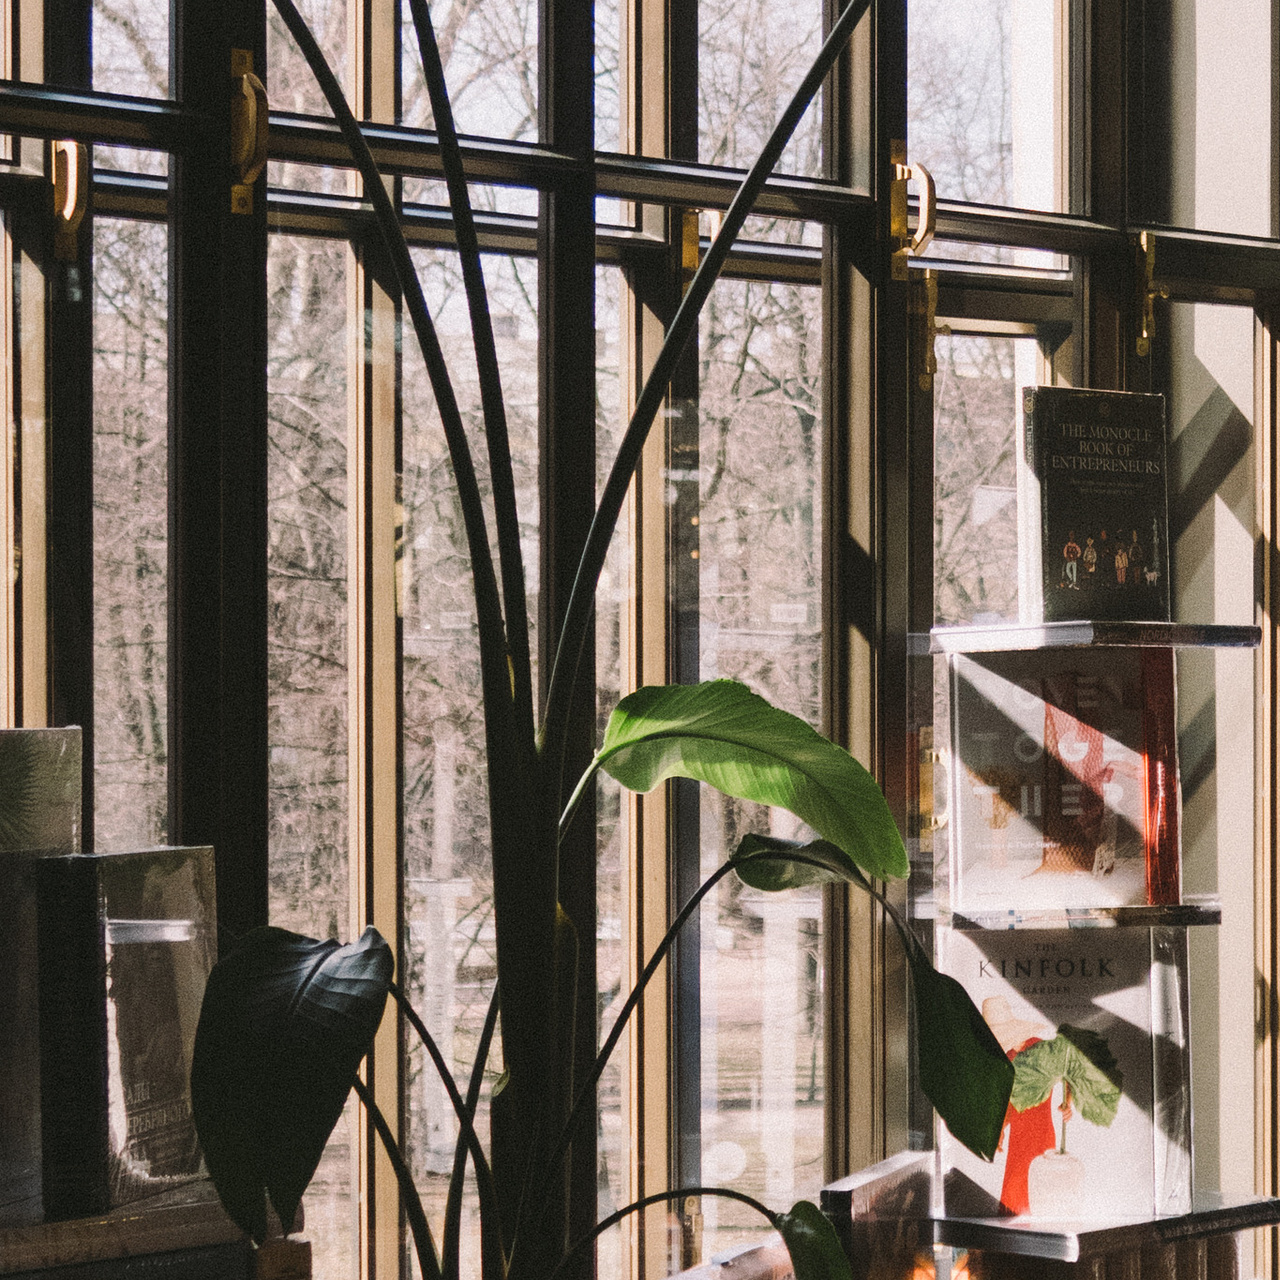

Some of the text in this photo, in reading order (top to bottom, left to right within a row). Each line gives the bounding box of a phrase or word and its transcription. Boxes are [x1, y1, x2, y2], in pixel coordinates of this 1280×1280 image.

[1059, 424, 1153, 442] THE MONOCLE
[1079, 441, 1134, 457] BOOK OF
[1052, 456, 1161, 475] ENTREPRENEURS
[1034, 943, 1059, 952] THE
[979, 958, 1115, 978] KINFOLK
[1022, 986, 1071, 995] GARDEN
